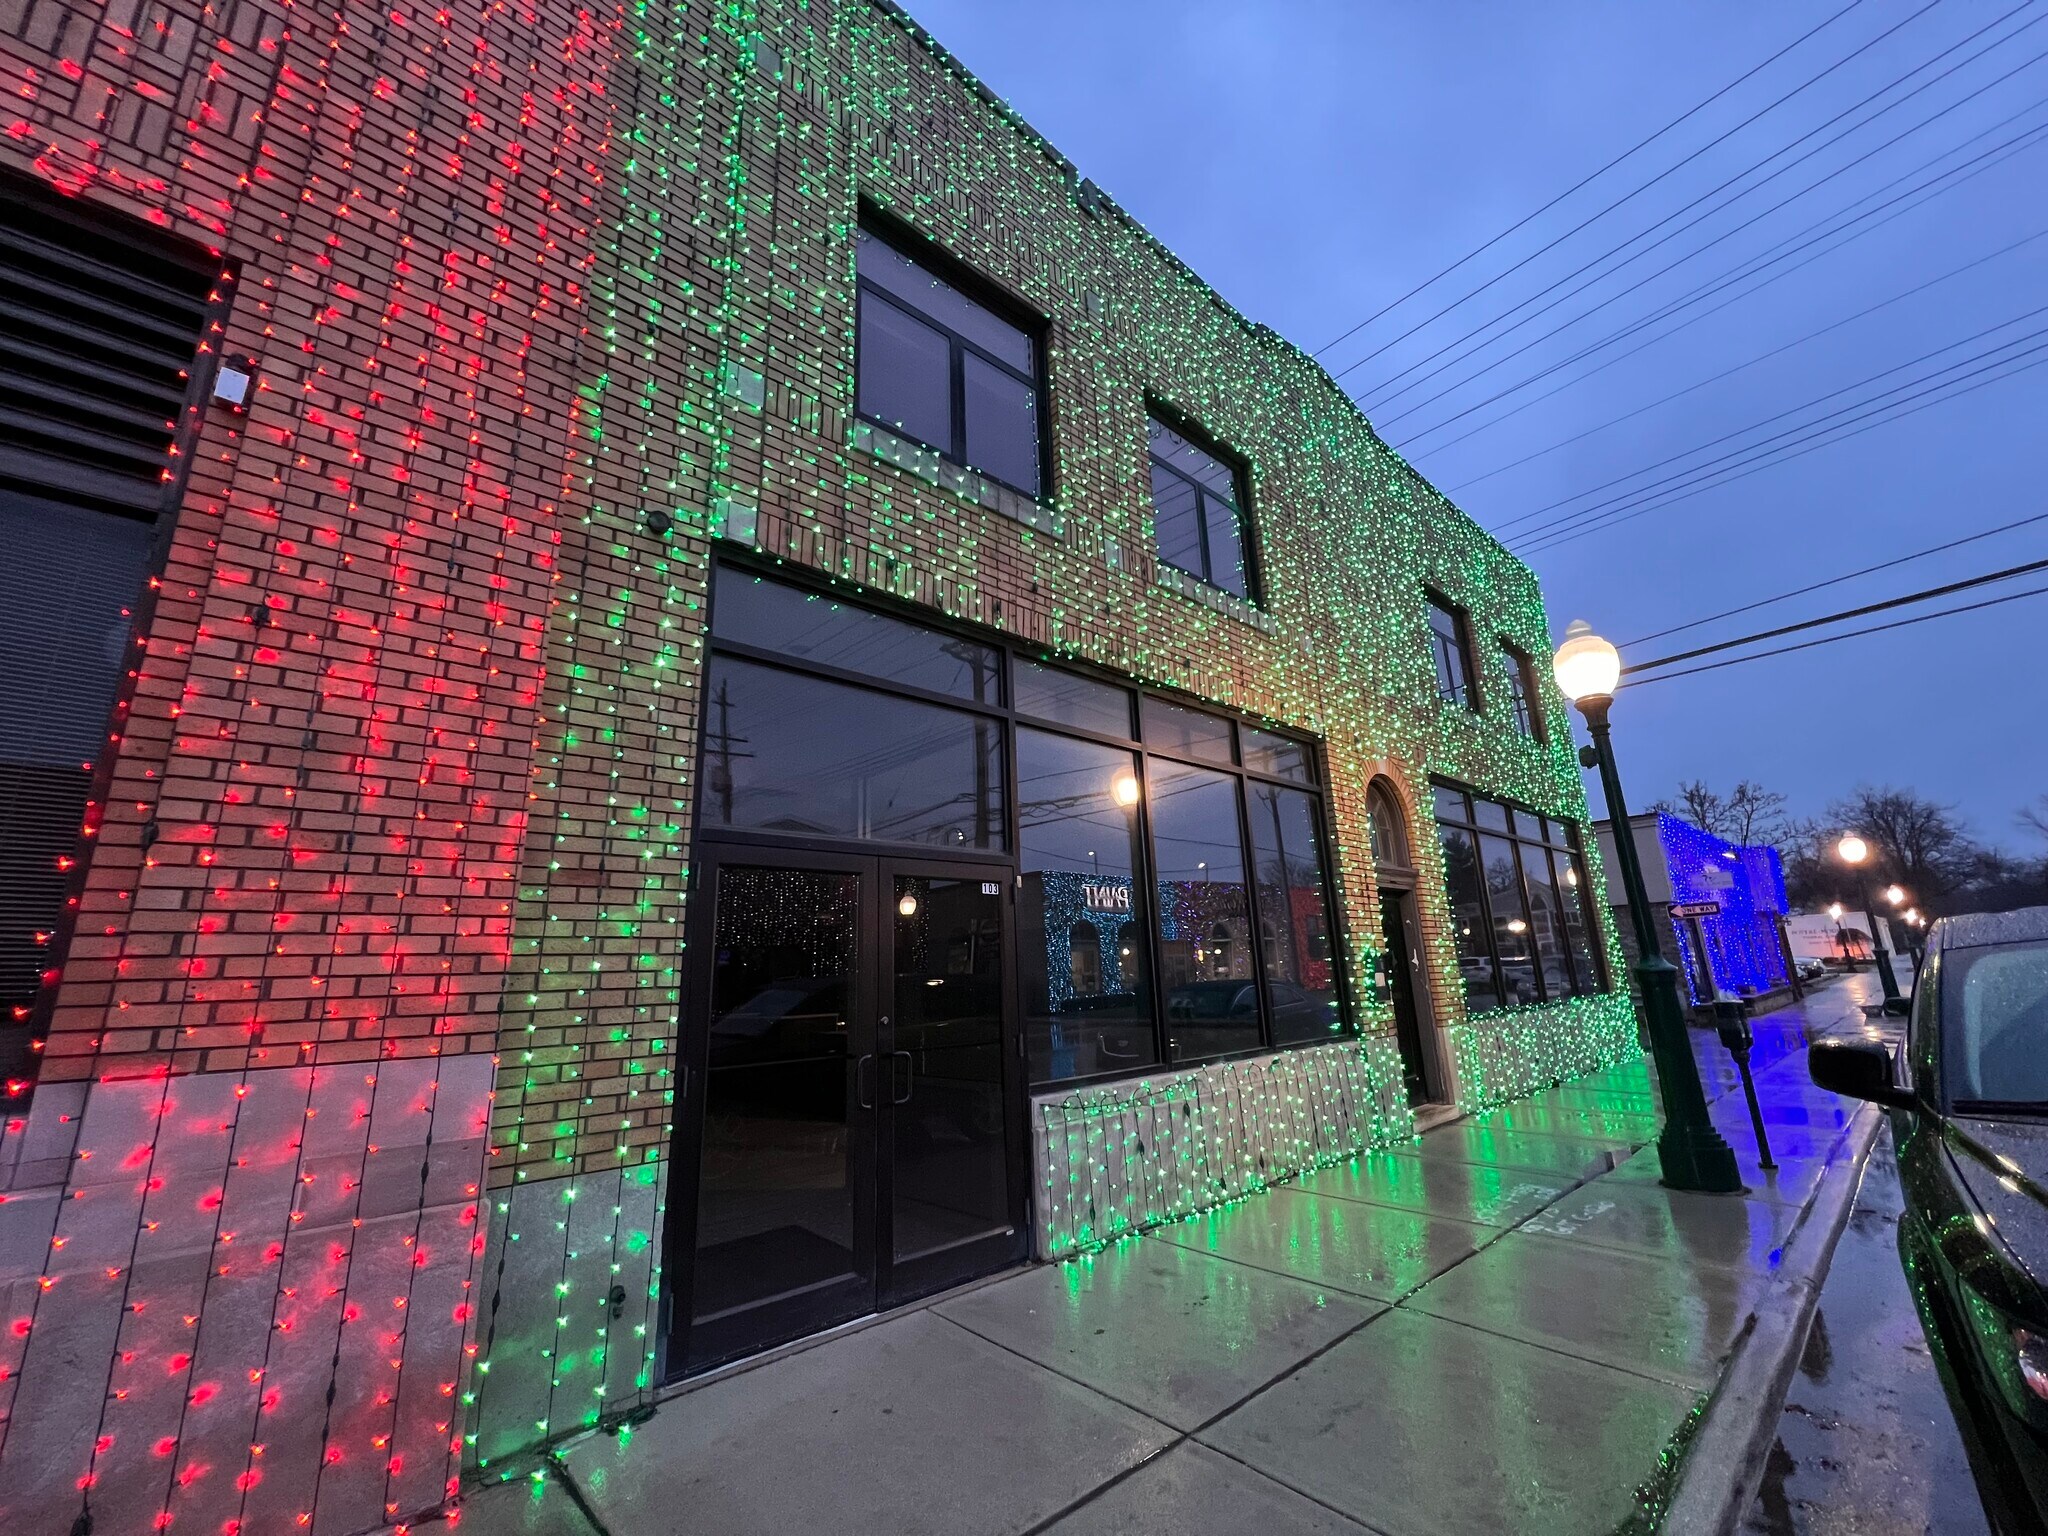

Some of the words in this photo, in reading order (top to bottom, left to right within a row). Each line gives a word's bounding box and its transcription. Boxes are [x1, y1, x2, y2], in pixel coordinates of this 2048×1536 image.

[983, 883, 998, 894] 103
[1682, 906, 1696, 914] ONE
[1699, 905, 1715, 913] WAY
